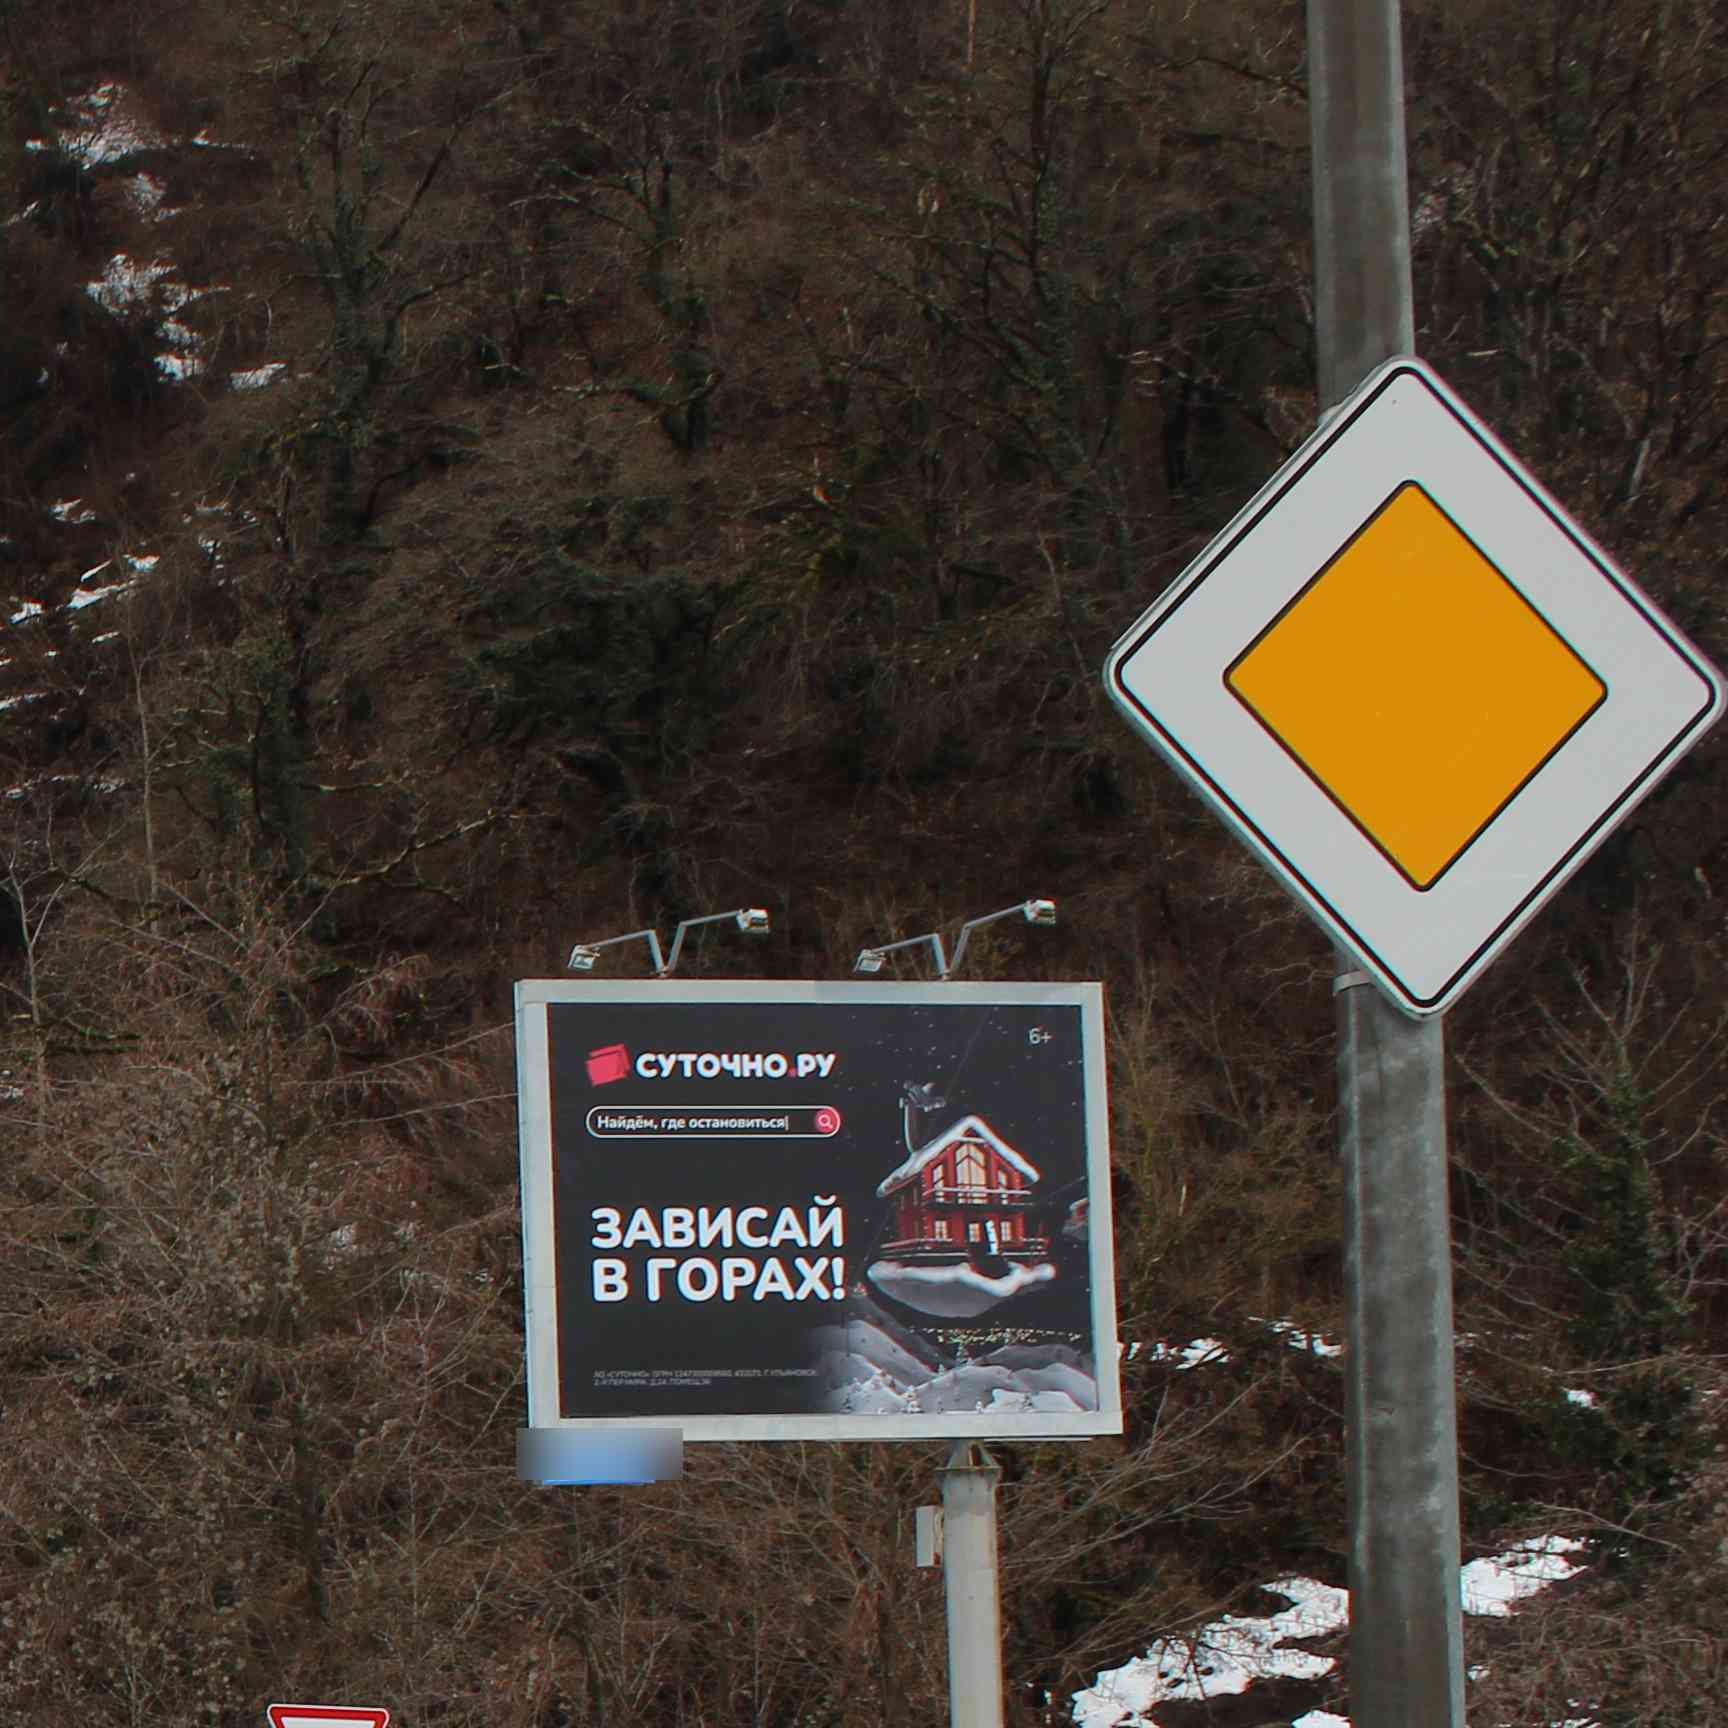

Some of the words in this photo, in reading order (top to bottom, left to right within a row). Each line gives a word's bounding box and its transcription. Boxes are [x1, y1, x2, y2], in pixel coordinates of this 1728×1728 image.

[1029, 1028, 1052, 1044] 6+
[636, 1052, 836, 1078] СУТОЧНО.РУ
[597, 1114, 658, 1130] Найдём,
[661, 1118, 686, 1130] где
[591, 1195, 844, 1249] ЗАВИСАЙ
[593, 1258, 629, 1302] В
[647, 1257, 845, 1302] ГОРАХ!
